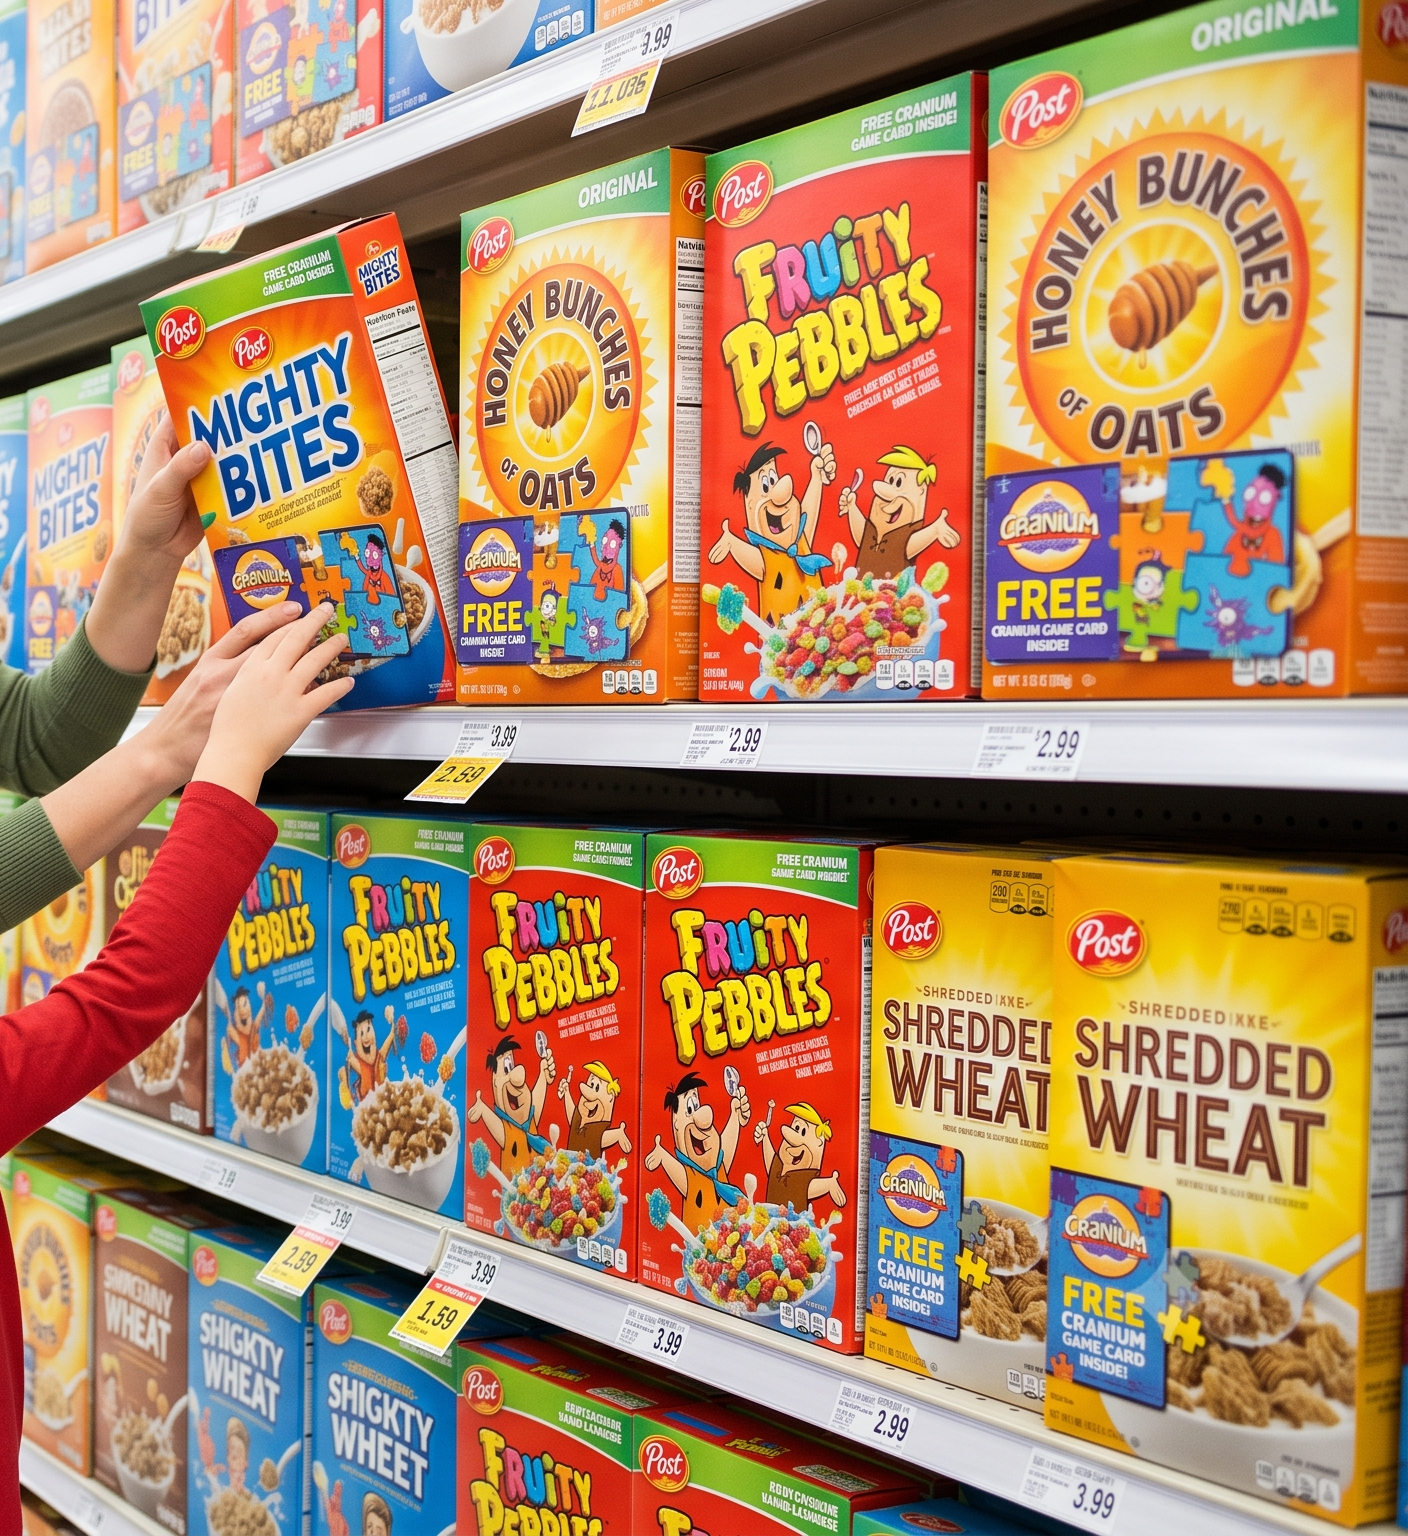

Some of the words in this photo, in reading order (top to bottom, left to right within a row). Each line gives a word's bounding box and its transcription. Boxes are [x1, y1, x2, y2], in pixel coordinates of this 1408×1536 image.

[1191, 0, 1339, 51] ORIGINAL
[851, 135, 882, 152] GAME
[883, 123, 913, 143] CARD
[915, 110, 958, 136] INSIDE!
[861, 114, 892, 134] FREE
[895, 91, 957, 123] CRANIUM
[1011, 84, 1072, 142] Post
[578, 167, 658, 208] ORIGINAL
[721, 171, 766, 219] Post
[358, 248, 398, 281] MIGHTY
[473, 225, 509, 266] Post
[1031, 171, 1122, 354] HONEY
[1137, 150, 1291, 326] BUNCHES
[263, 265, 287, 284] FREE
[364, 264, 400, 296] BITES
[161, 311, 198, 353] Post
[234, 332, 267, 364] Post
[484, 292, 536, 427] HONEY
[544, 278, 631, 411] BUNCHES
[722, 255, 943, 437] PEBBLES
[190, 336, 350, 456] MIGHTY
[1058, 387, 1089, 420] OF
[1090, 385, 1225, 457] OATS
[33, 432, 110, 510] MIGHTY
[218, 404, 361, 518] BITES
[501, 457, 520, 481] OF
[519, 456, 597, 511] OATS
[38, 482, 101, 551] BITES
[463, 600, 523, 634] FREE
[996, 576, 1103, 621] FREE
[1026, 639, 1070, 652] INSIDE!
[1075, 621, 1109, 635] CARD
[479, 844, 510, 875] Post
[574, 840, 594, 852] FREE
[776, 854, 801, 866] FREE
[802, 855, 848, 869] CRANIUM
[240, 864, 302, 916] RUITY
[659, 854, 697, 888] Post
[888, 909, 935, 946] Post
[1075, 918, 1137, 962] Post
[342, 919, 457, 1003] PEBBLES
[482, 937, 621, 1031] PEBBLES
[923, 985, 992, 1005] SHREDDED
[661, 960, 833, 1066] PEBBLES
[1128, 1000, 1226, 1025] SHREDDED
[1074, 1018, 1332, 1103] SHREDDED
[1076, 1074, 1327, 1188] WHEAT
[878, 1226, 945, 1272] FREE
[471, 1260, 496, 1285] 3.99
[877, 1258, 945, 1291] CRANIUM
[879, 1276, 912, 1298] GAME
[912, 1283, 945, 1306] CARD
[417, 1300, 459, 1330] 1.59
[1062, 1275, 1145, 1329] FREE
[105, 1293, 172, 1363] WHEAT
[652, 1327, 683, 1356] 3.99
[1061, 1310, 1146, 1351] CRANIUM
[1062, 1331, 1103, 1358] GAME
[1103, 1342, 1145, 1368] CARD
[1079, 1352, 1129, 1380] INSIDE!
[203, 1348, 281, 1424] WHEAT
[467, 1371, 499, 1400] Post
[873, 1408, 909, 1442] 2.99
[331, 1412, 428, 1501] WHEET
[646, 1442, 684, 1475] Post
[1072, 1482, 1116, 1520] 3.99
